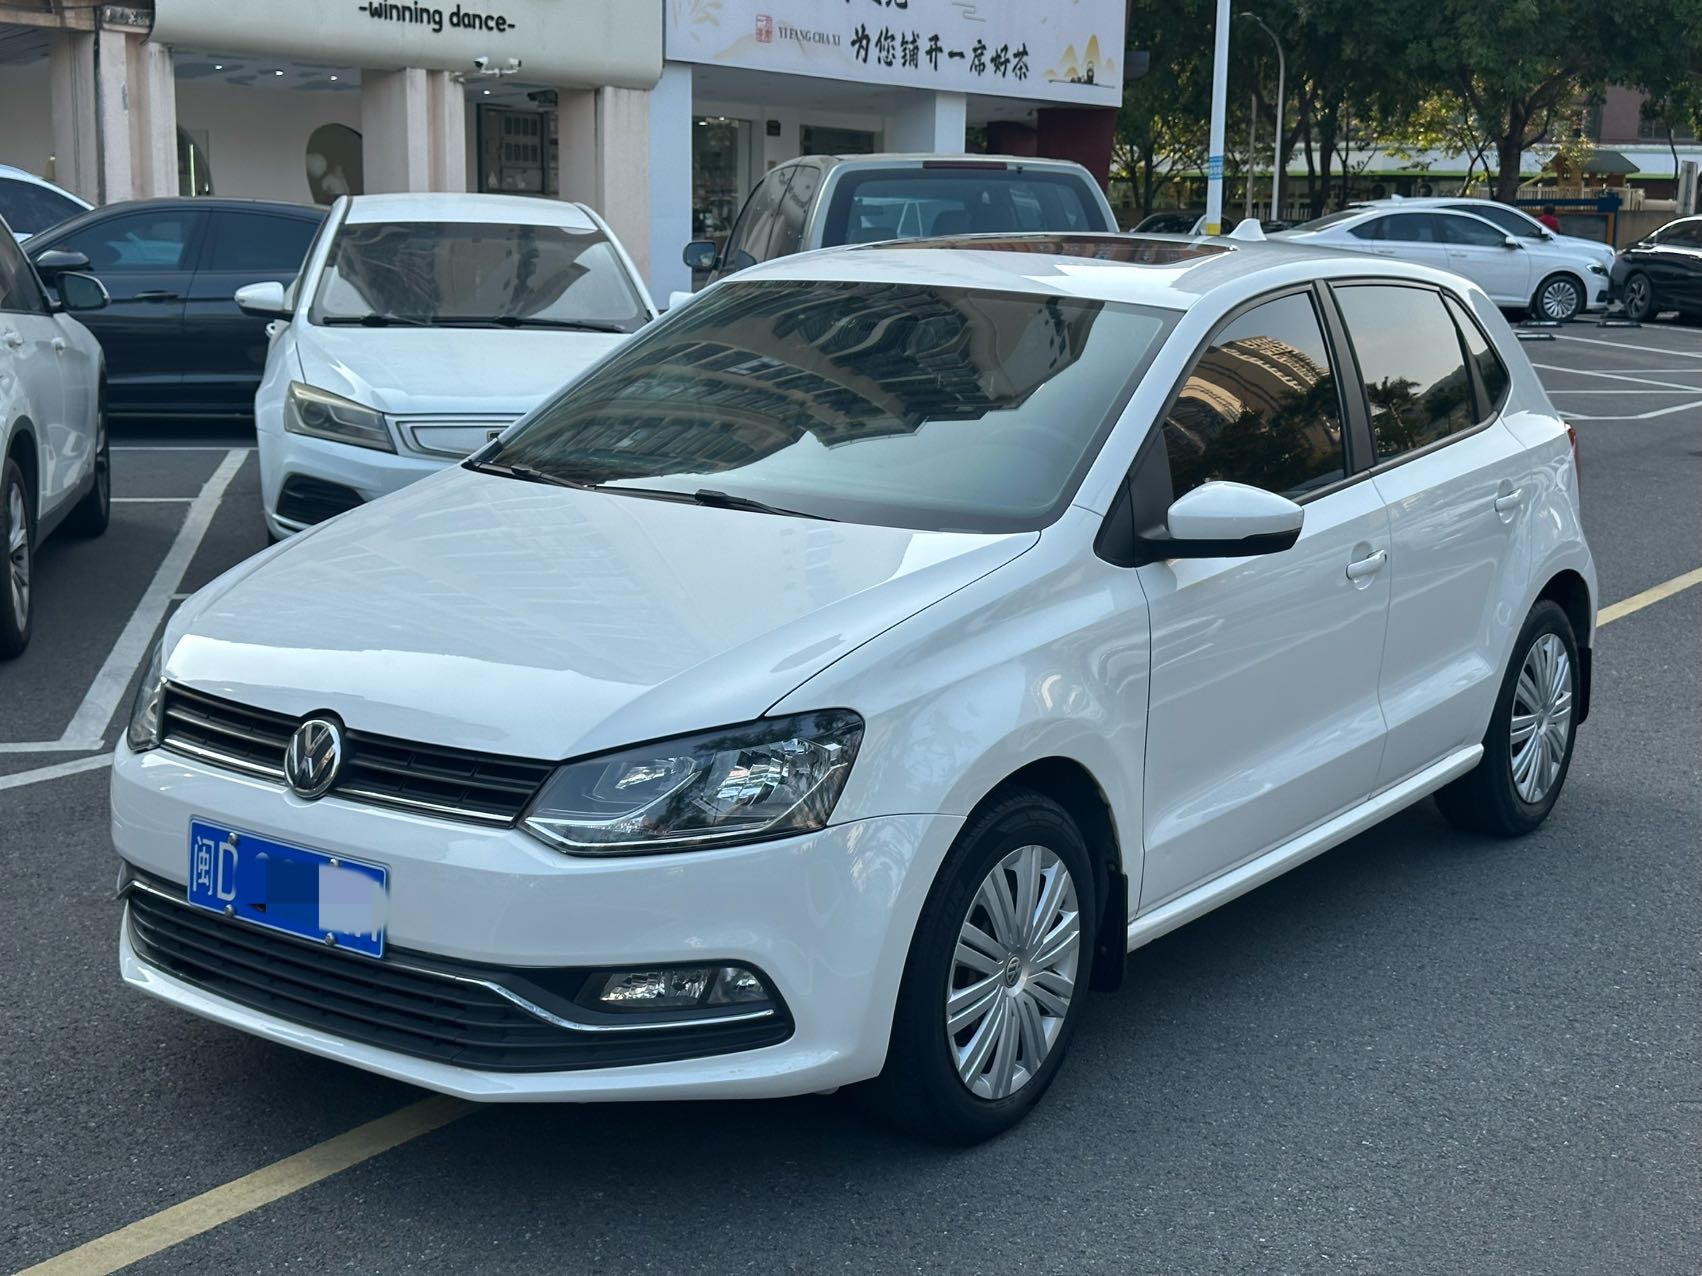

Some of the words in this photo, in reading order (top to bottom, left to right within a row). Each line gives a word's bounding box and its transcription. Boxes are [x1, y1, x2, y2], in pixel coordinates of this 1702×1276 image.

[788, 27, 811, 42] FANG
[812, 32, 830, 46] CHA
[851, 23, 1029, 81] 为您铺开一席好茶
